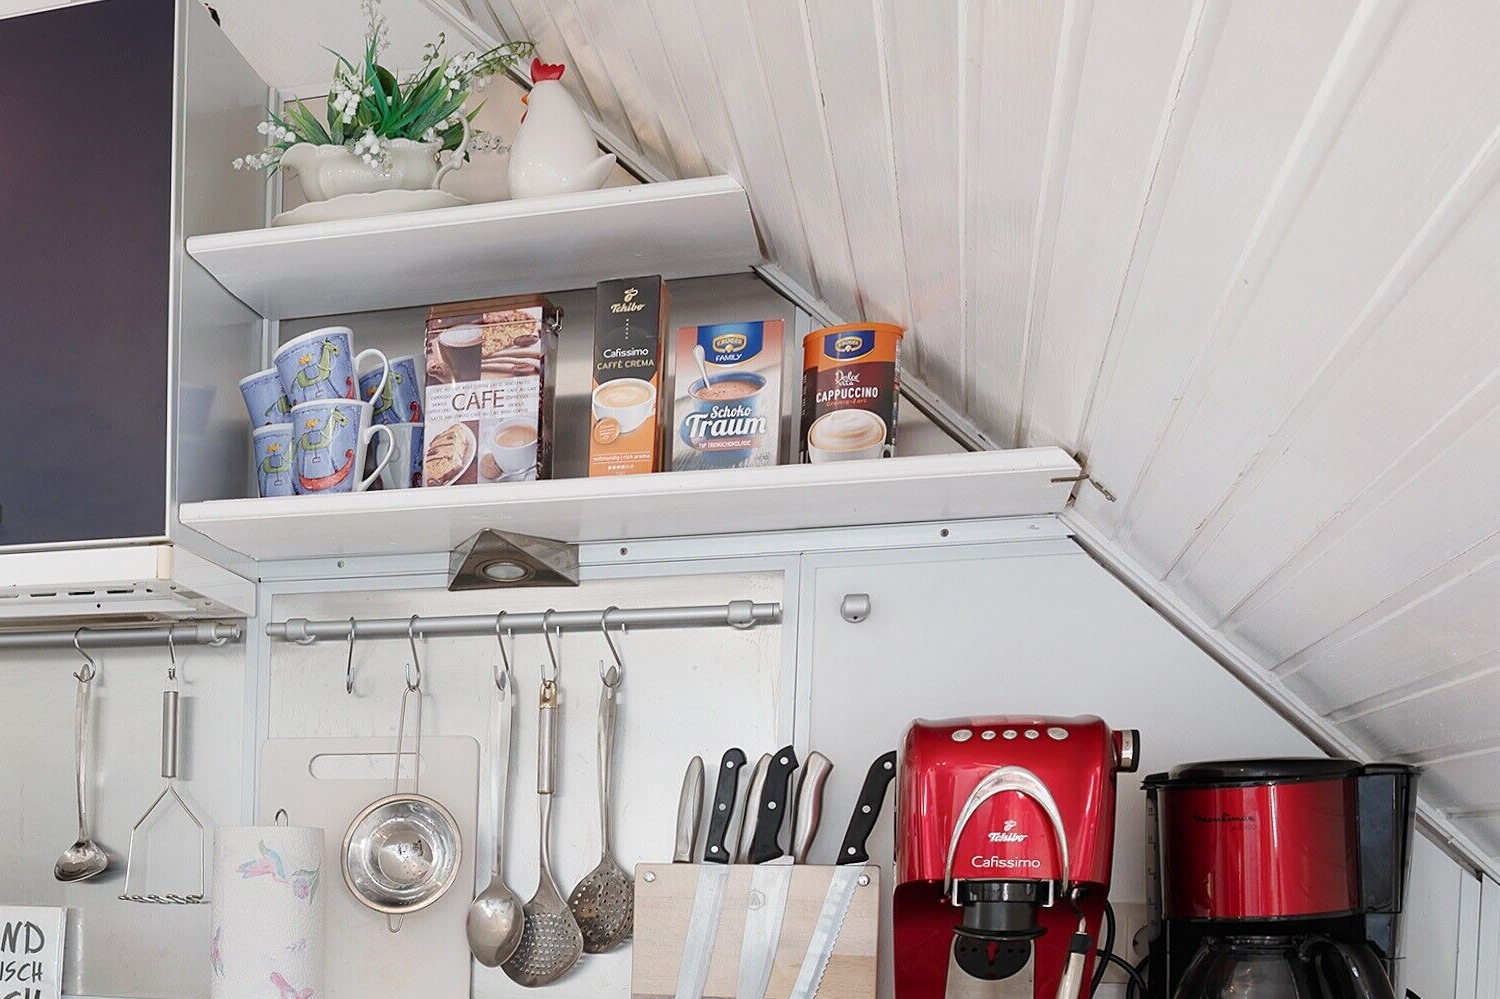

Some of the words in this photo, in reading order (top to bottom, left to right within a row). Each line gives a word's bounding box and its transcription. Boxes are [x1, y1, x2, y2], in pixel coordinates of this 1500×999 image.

[610, 302, 646, 314] Tchibo
[603, 347, 649, 359] Cafissimo
[715, 353, 743, 362] FAMILY
[624, 359, 655, 369] CREMA
[451, 389, 505, 412] CAFE
[815, 386, 879, 404] CAPPUCCINO
[709, 404, 753, 419] Schoko
[685, 414, 767, 439] Traum
[987, 832, 1029, 843] Tchibo
[971, 855, 1041, 869] Cafissimo
